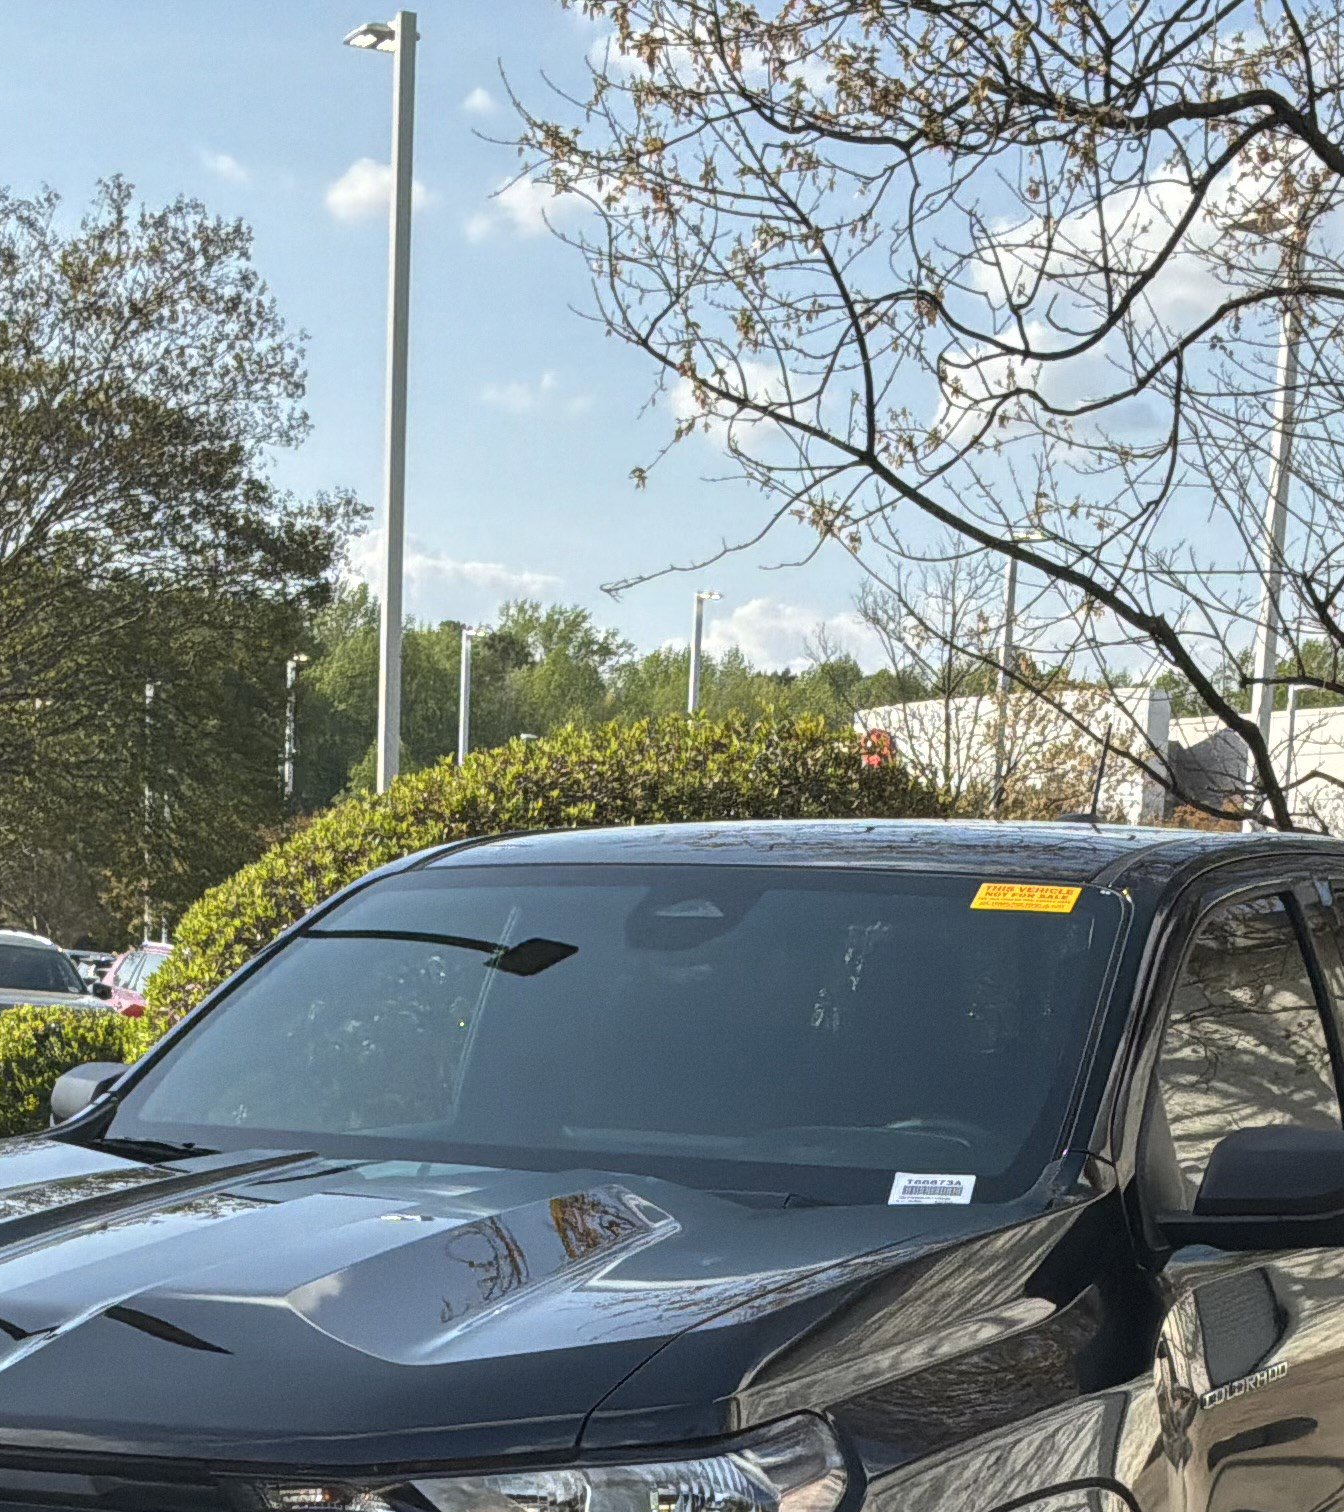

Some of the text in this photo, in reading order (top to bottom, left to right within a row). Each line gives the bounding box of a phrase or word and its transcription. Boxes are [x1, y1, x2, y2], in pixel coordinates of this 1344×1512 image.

[986, 885, 1074, 895] THIS VEHICLE
[1203, 1361, 1289, 1410] COLORADO
